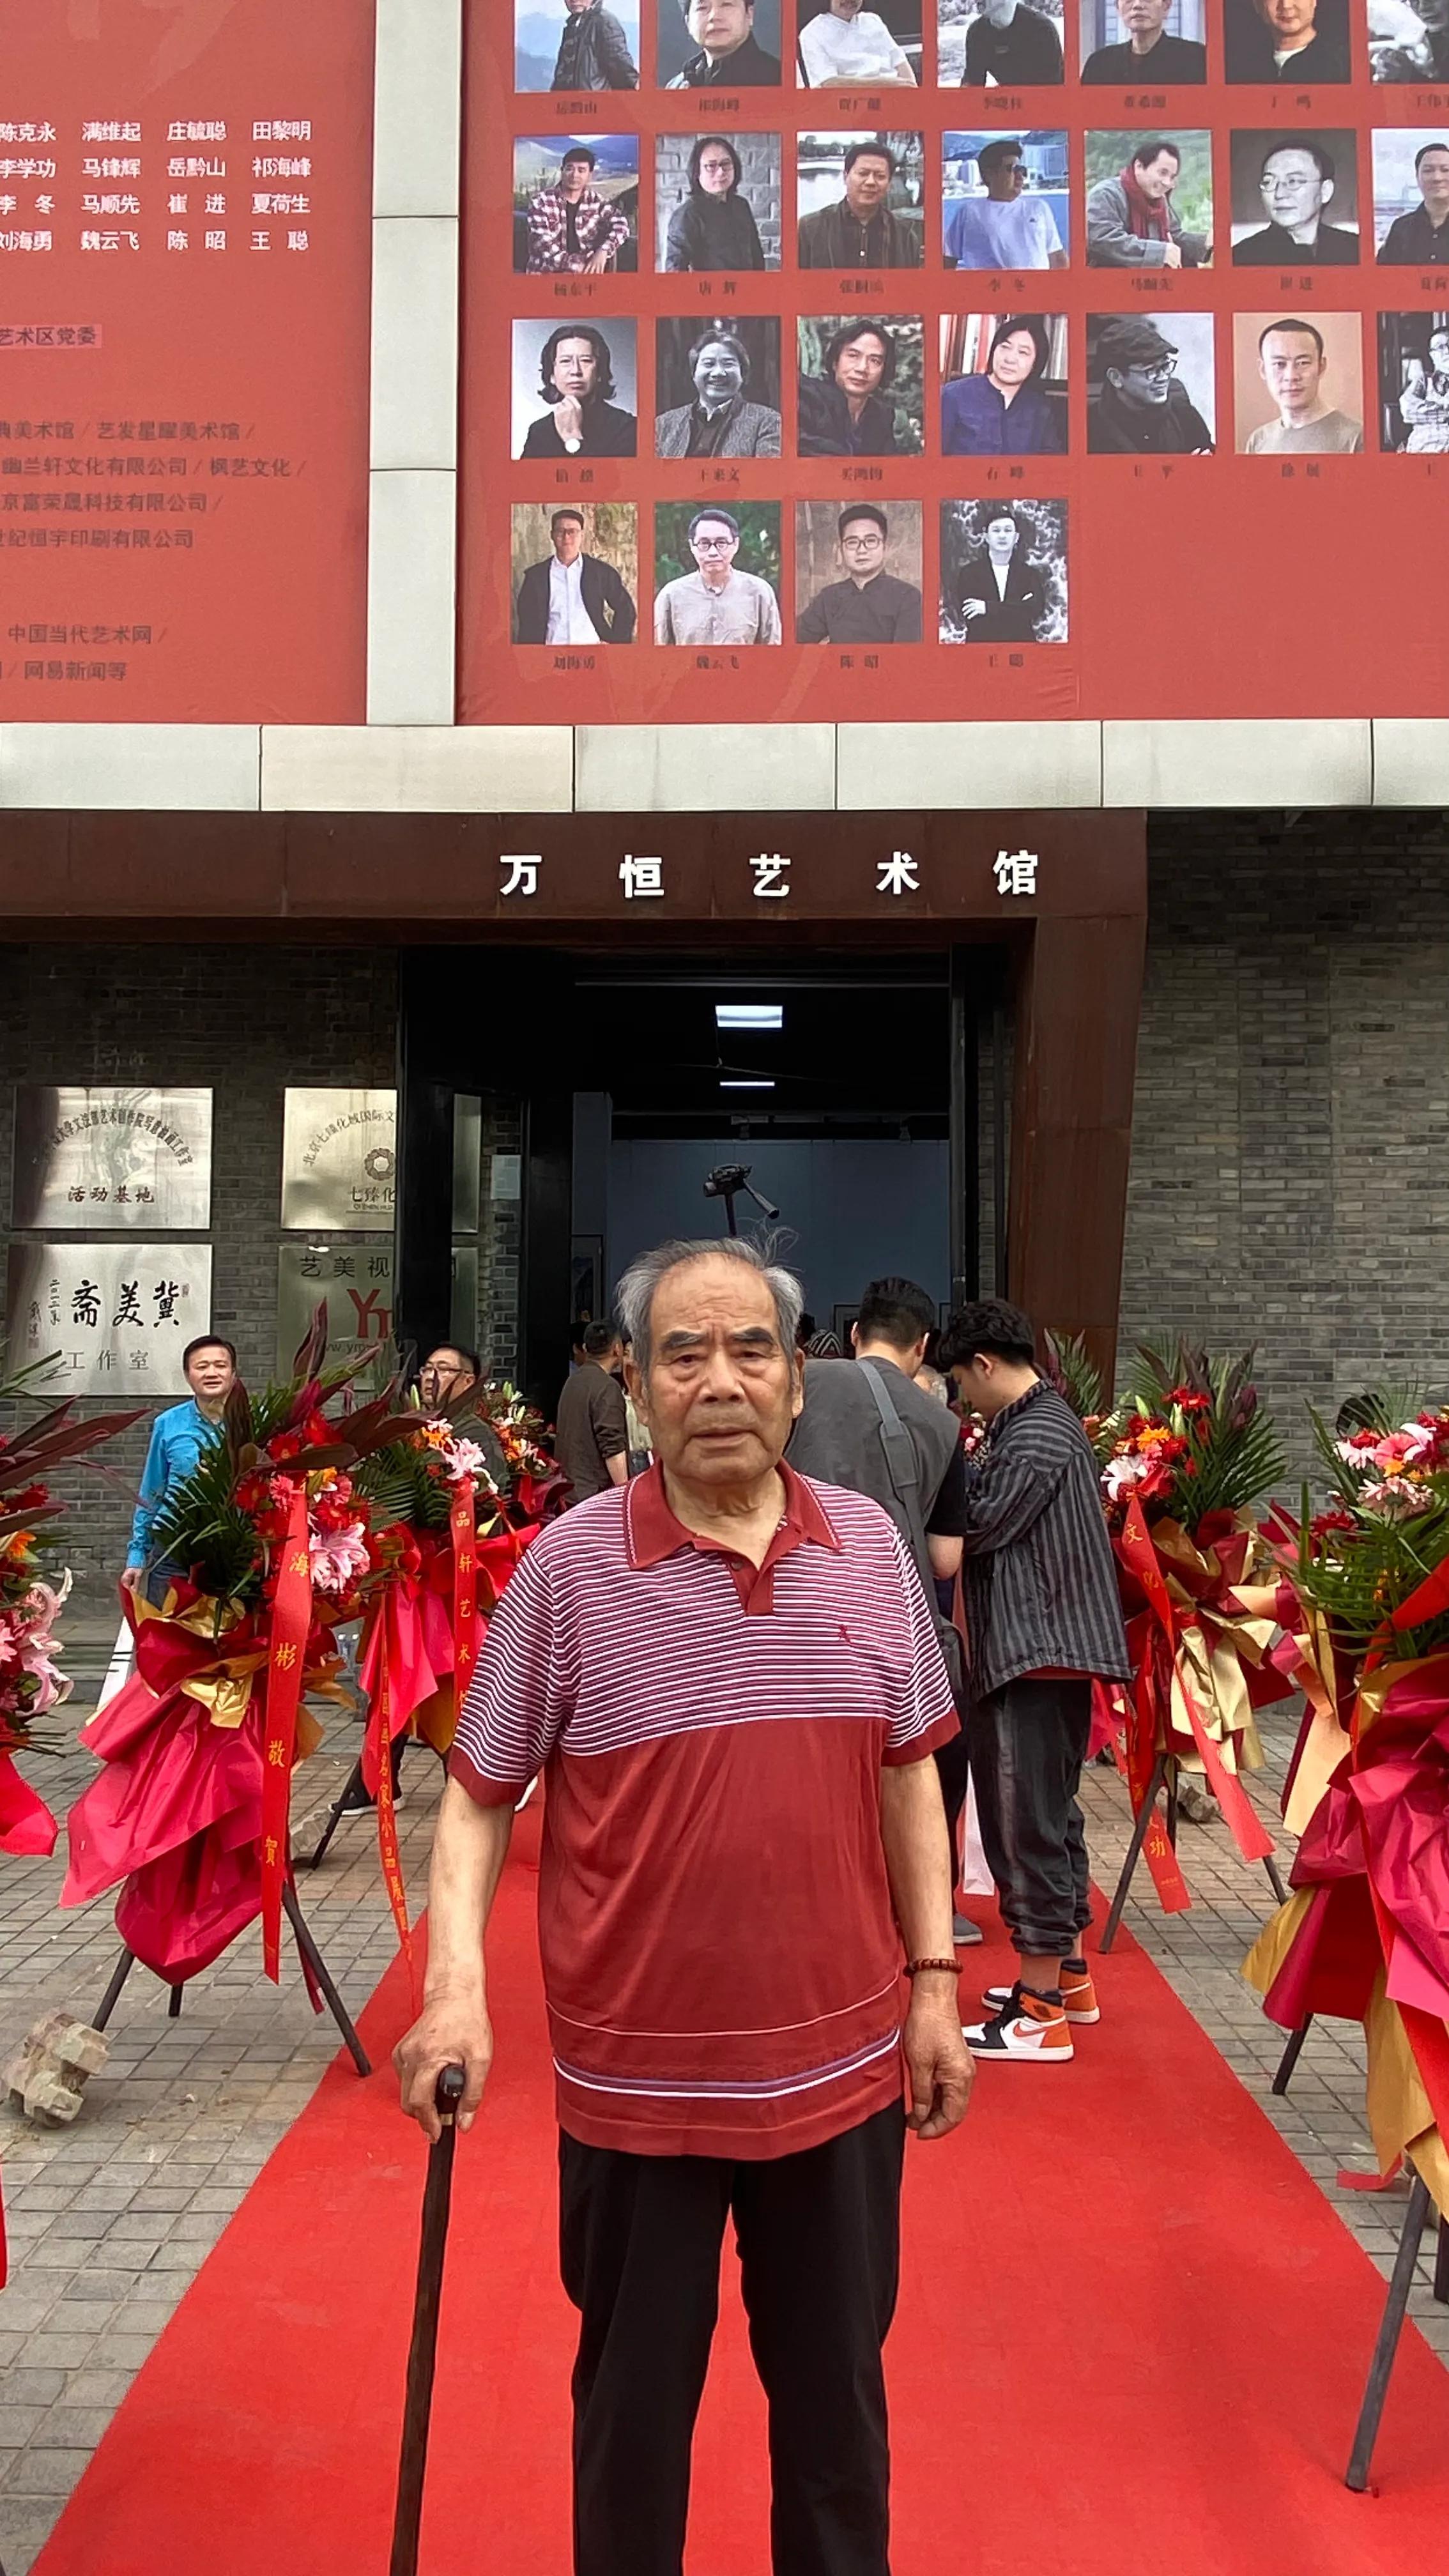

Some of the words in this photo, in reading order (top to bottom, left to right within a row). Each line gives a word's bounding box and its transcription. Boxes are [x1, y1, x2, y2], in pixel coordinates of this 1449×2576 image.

[0, 121, 56, 142] 陈克永
[82, 121, 141, 142] 满维起
[253, 120, 311, 141] 田黎明
[0, 158, 56, 178] 李学功
[82, 157, 141, 178] 马锋辉
[167, 157, 226, 178] 岳黔山
[252, 157, 312, 178] 祁海峰
[80, 194, 141, 214] 马顺先
[251, 194, 310, 214] 夏荷生
[80, 231, 140, 250] 魏云飞
[500, 851, 1039, 899] 万恒艺术馆
[68, 1185, 155, 1203] 活动基地
[66, 1349, 150, 1371] 工作室
